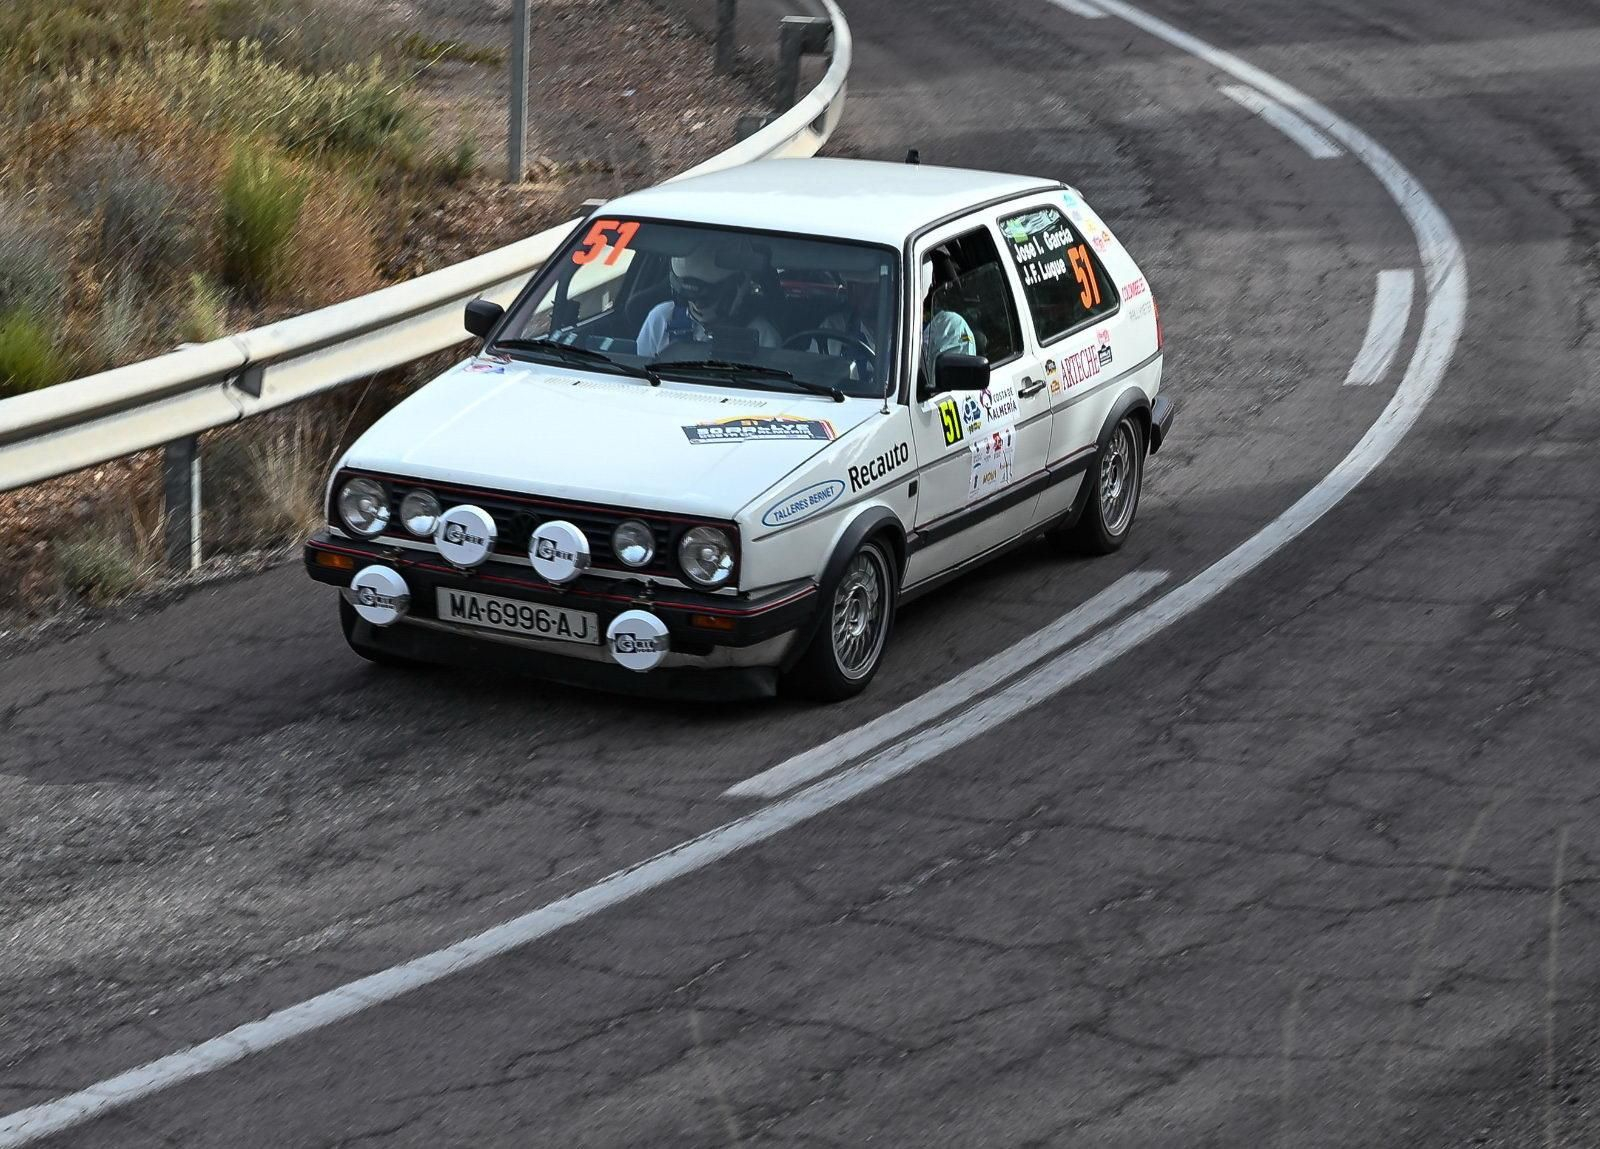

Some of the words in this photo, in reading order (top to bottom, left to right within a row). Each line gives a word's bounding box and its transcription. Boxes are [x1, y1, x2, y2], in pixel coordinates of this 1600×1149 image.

[571, 219, 640, 266] 51
[1014, 242, 1037, 264] Jose
[1043, 225, 1074, 251] García
[1067, 244, 1101, 309] 51
[1060, 345, 1100, 391] ARTECHE
[938, 399, 961, 443] 51
[847, 441, 909, 493] Recauto
[773, 496, 809, 522] TALLERES
[808, 486, 835, 506] BERNET
